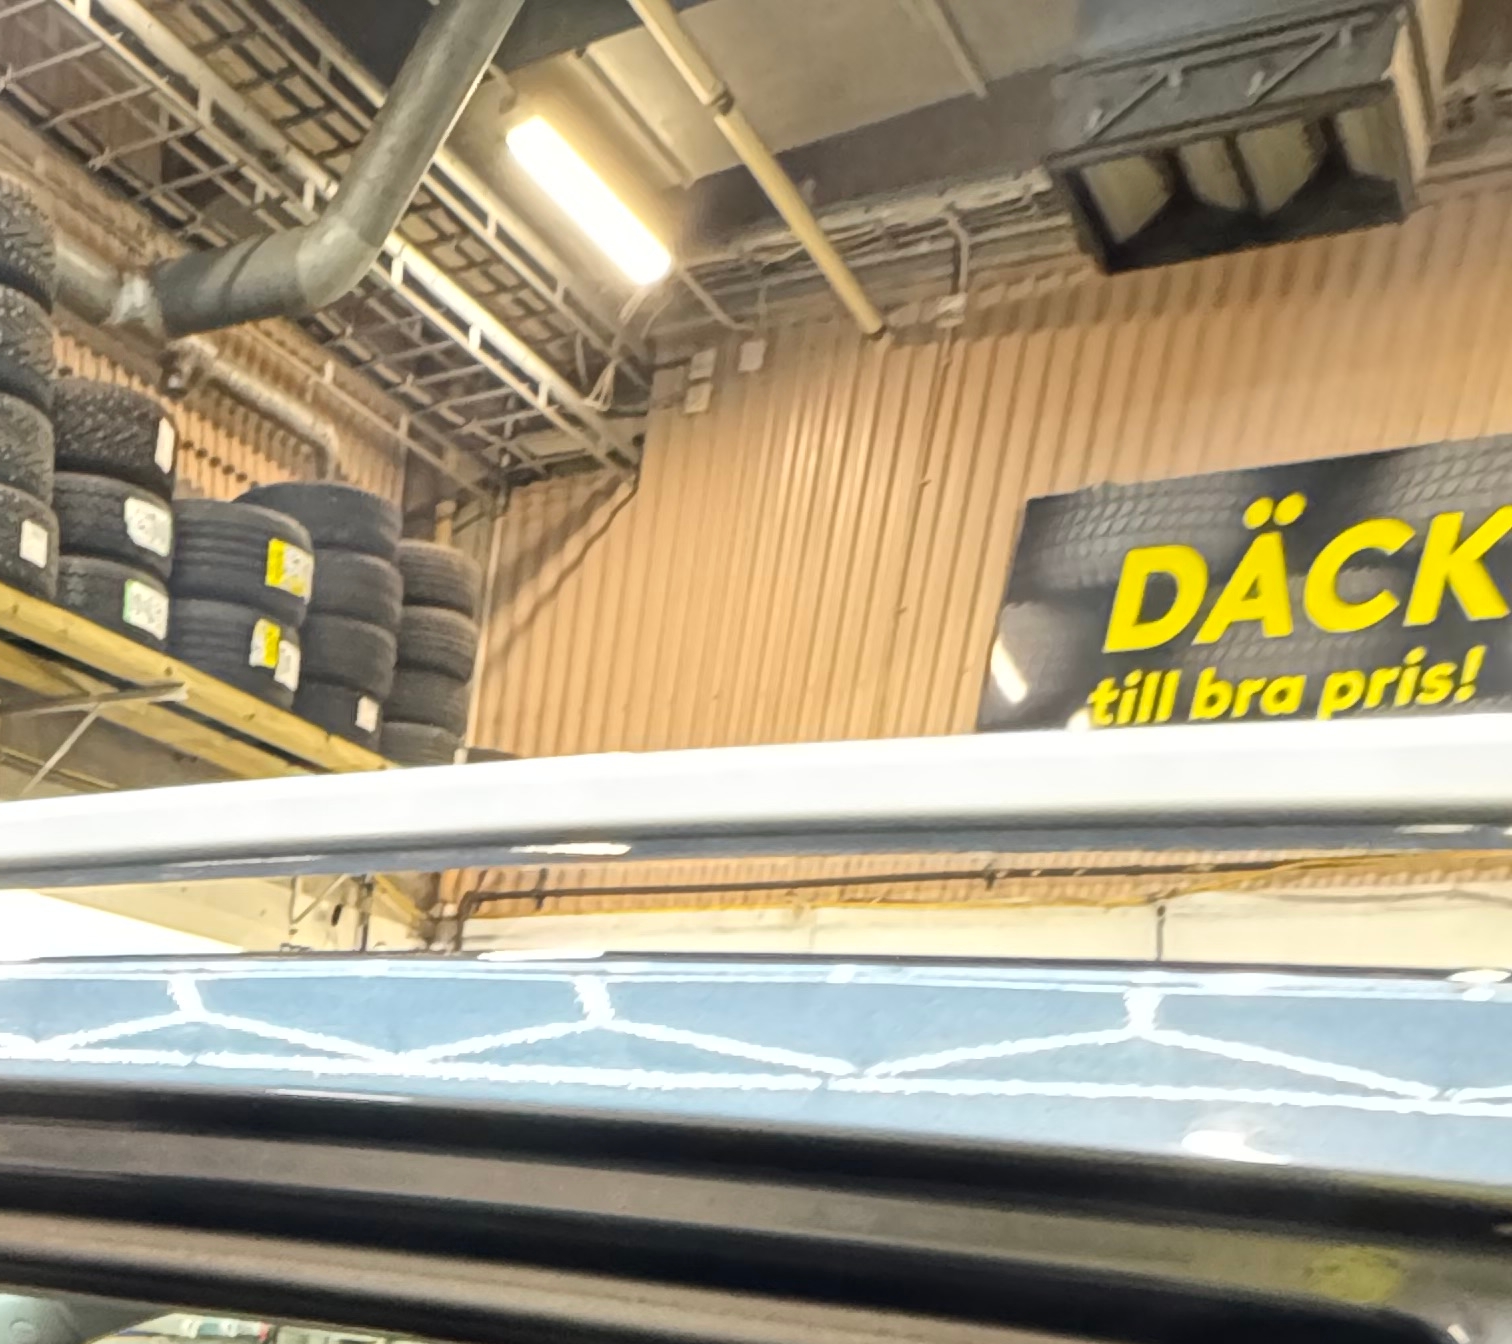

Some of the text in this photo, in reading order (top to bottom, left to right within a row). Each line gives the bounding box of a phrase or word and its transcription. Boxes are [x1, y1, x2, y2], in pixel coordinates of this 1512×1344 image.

[1101, 492, 1512, 653] DÄCK
[1087, 644, 1488, 726] till bra pris!
